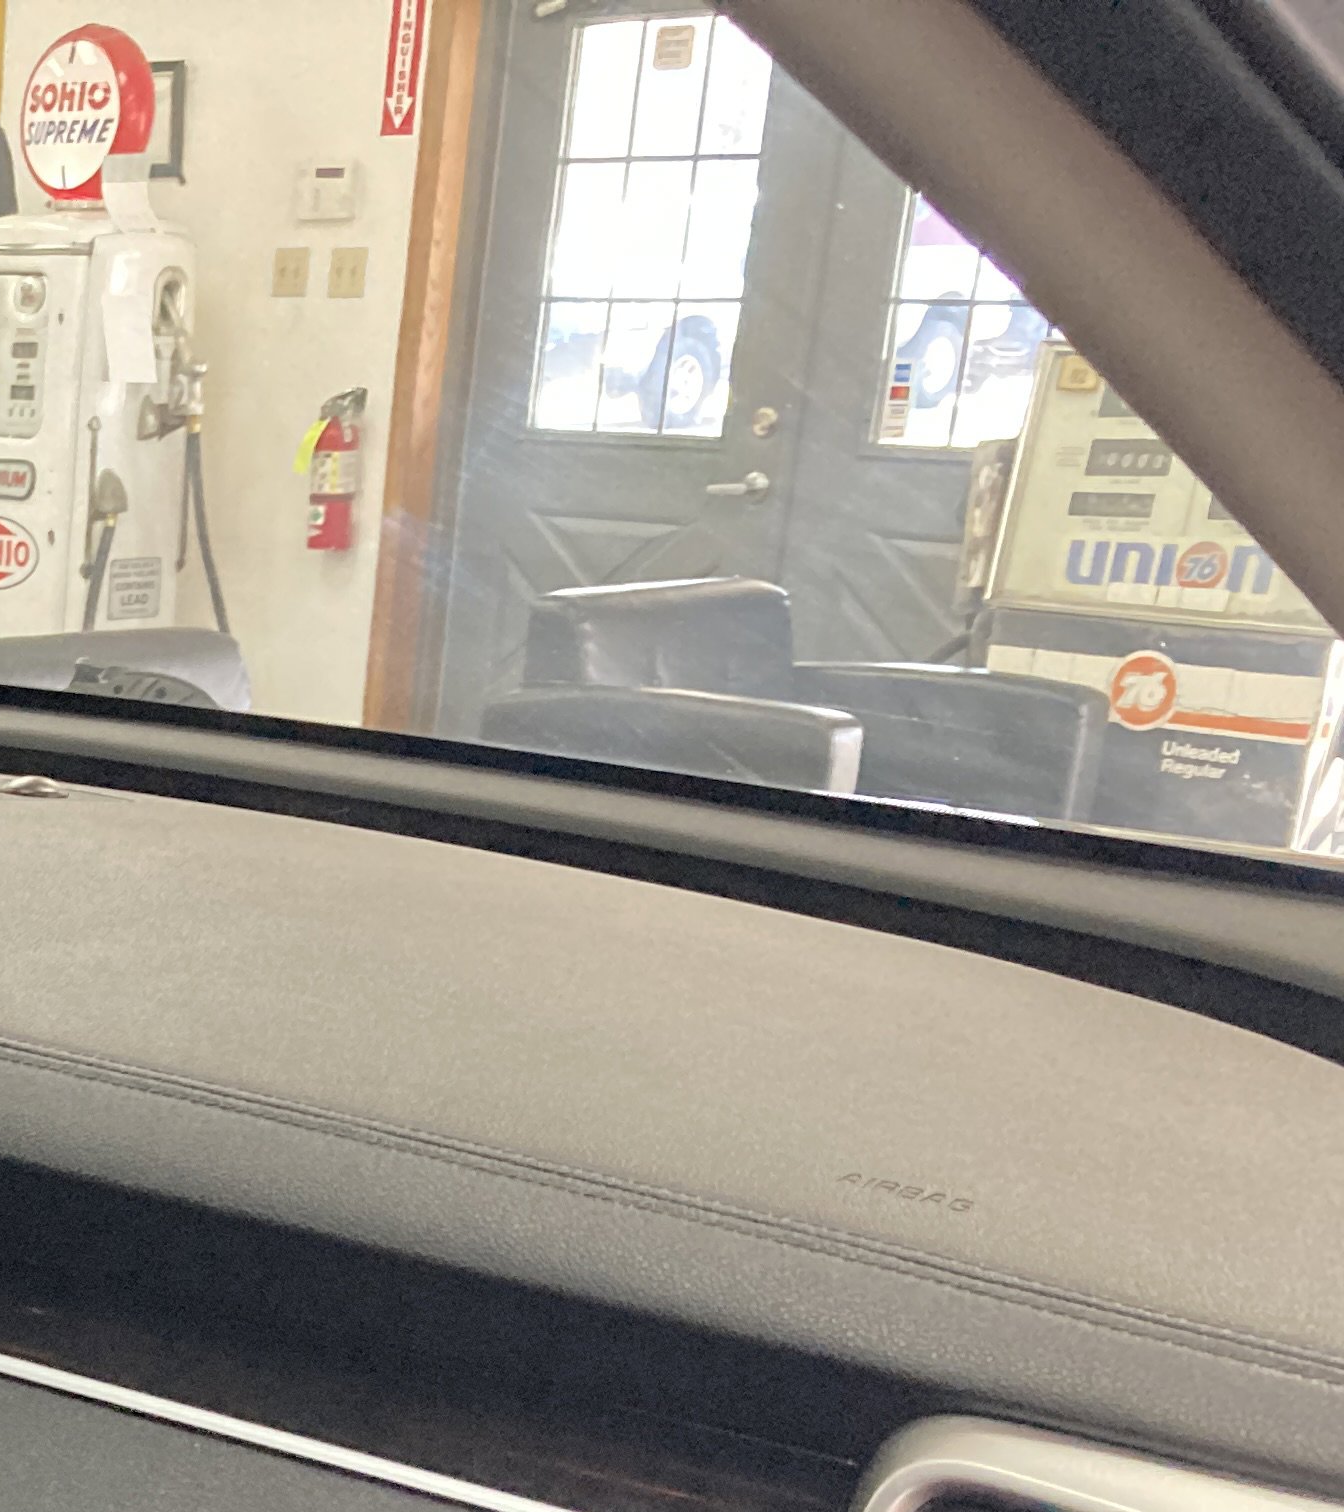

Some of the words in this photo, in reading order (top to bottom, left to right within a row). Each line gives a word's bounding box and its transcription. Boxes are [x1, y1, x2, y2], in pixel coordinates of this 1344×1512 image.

[393, 0, 414, 117] INGUISHER
[29, 81, 112, 114] SOHIO
[25, 118, 115, 146] SUPREME
[1115, 671, 1170, 712] 76
[1160, 758, 1227, 780] Regular
[1161, 740, 1242, 766] Unleaded
[835, 1172, 975, 1213] AIRBAG
